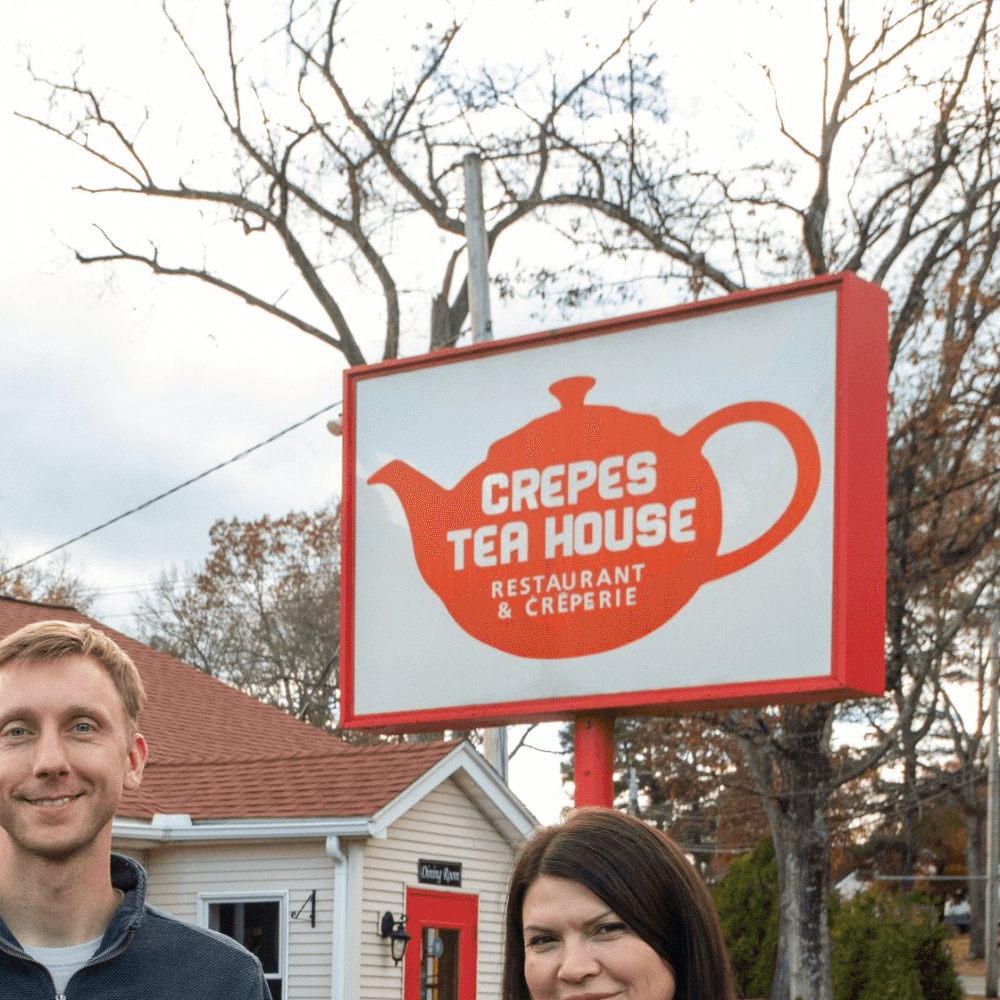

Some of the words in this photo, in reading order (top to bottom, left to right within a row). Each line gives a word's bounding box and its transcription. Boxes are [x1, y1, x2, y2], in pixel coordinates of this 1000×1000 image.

[481, 450, 657, 516] CREPES
[446, 520, 529, 571] TEA
[544, 497, 697, 560] HOUSE
[491, 563, 645, 599] RESTAURANT
[497, 601, 512, 620] &
